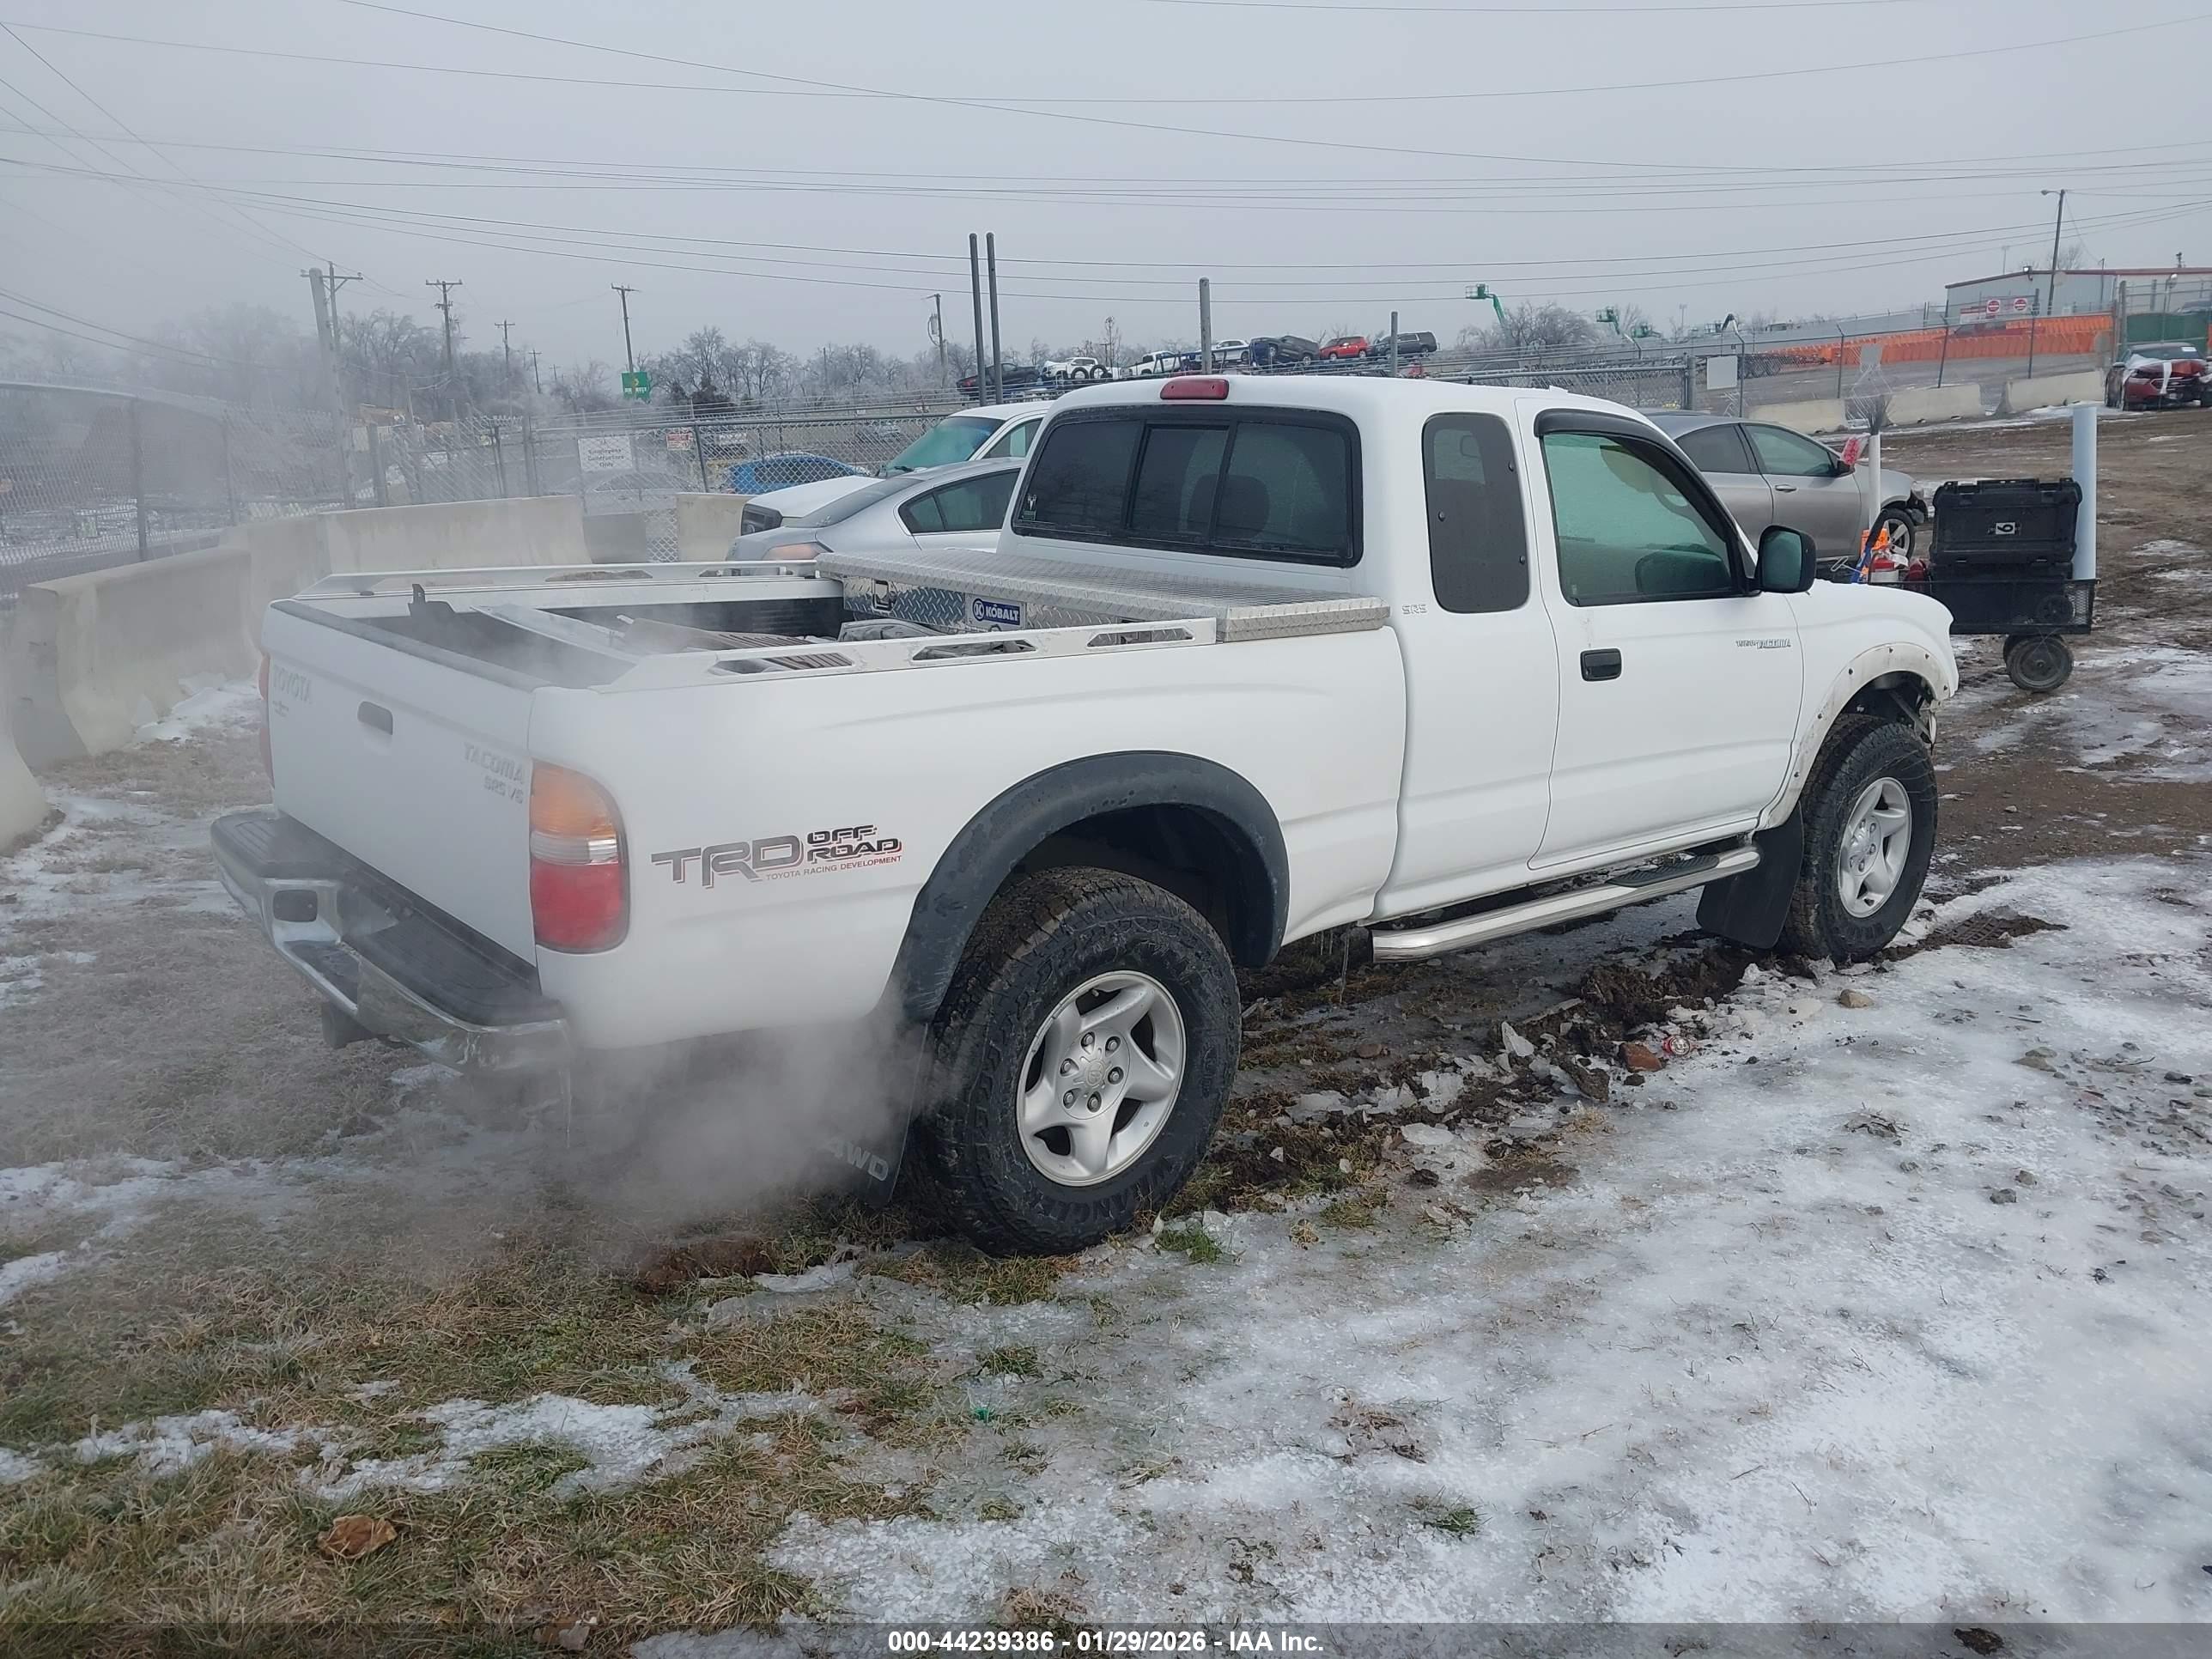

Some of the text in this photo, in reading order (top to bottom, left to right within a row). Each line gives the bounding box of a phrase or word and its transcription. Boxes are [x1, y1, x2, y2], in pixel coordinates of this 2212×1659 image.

[272, 665, 312, 704] TOYOTA
[464, 741, 523, 785] TACOMA
[507, 785, 524, 805] V6
[807, 824, 878, 845] OFF
[651, 835, 804, 890] TRD
[806, 838, 902, 864] ROAD
[766, 855, 902, 881] TOYOTA RACING DEVELOPMENT
[827, 1137, 890, 1182] 4WD
